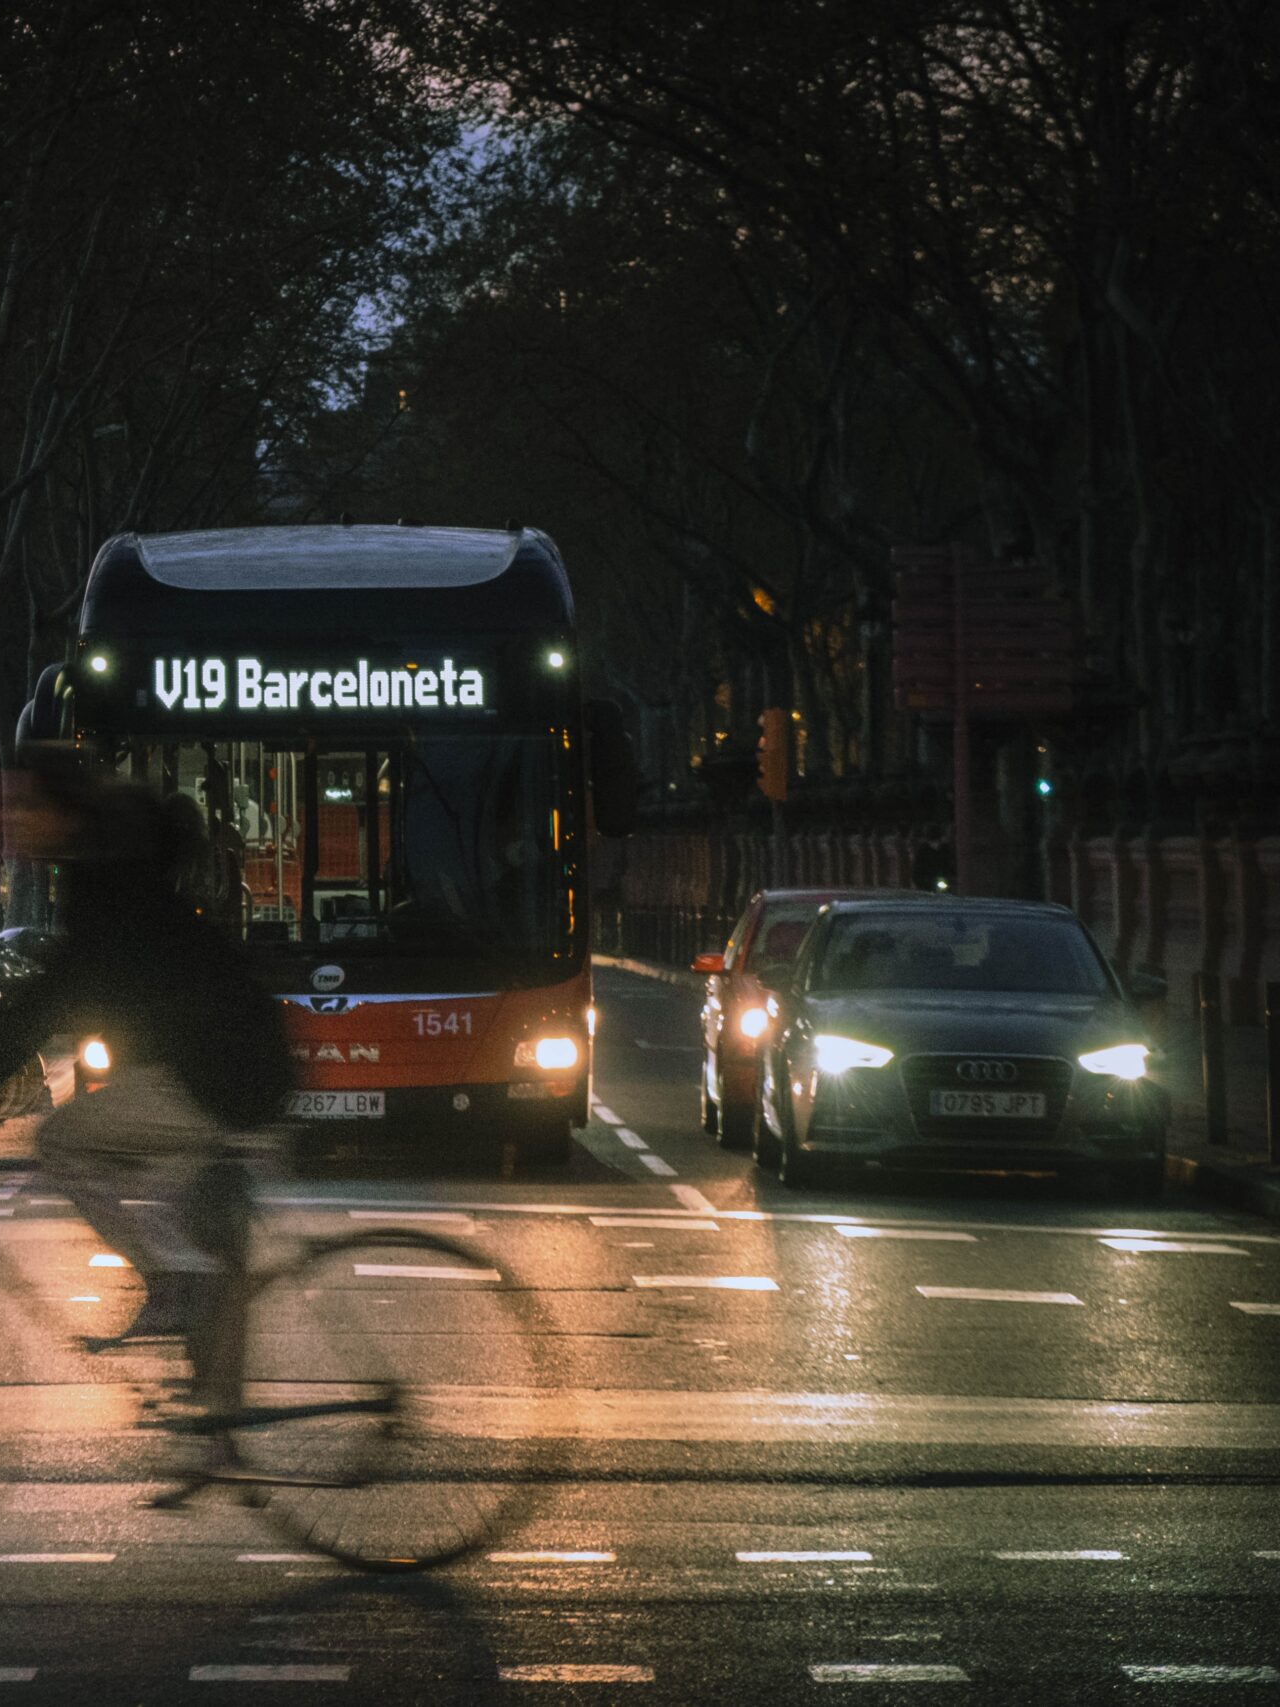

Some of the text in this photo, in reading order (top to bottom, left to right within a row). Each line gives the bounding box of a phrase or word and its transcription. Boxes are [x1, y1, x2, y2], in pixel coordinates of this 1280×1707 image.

[154, 658, 484, 709] V19 Barceloneta
[412, 1011, 473, 1036] 1541
[344, 1094, 381, 1113] LBW
[943, 1093, 1041, 1115] 0795 JPT
